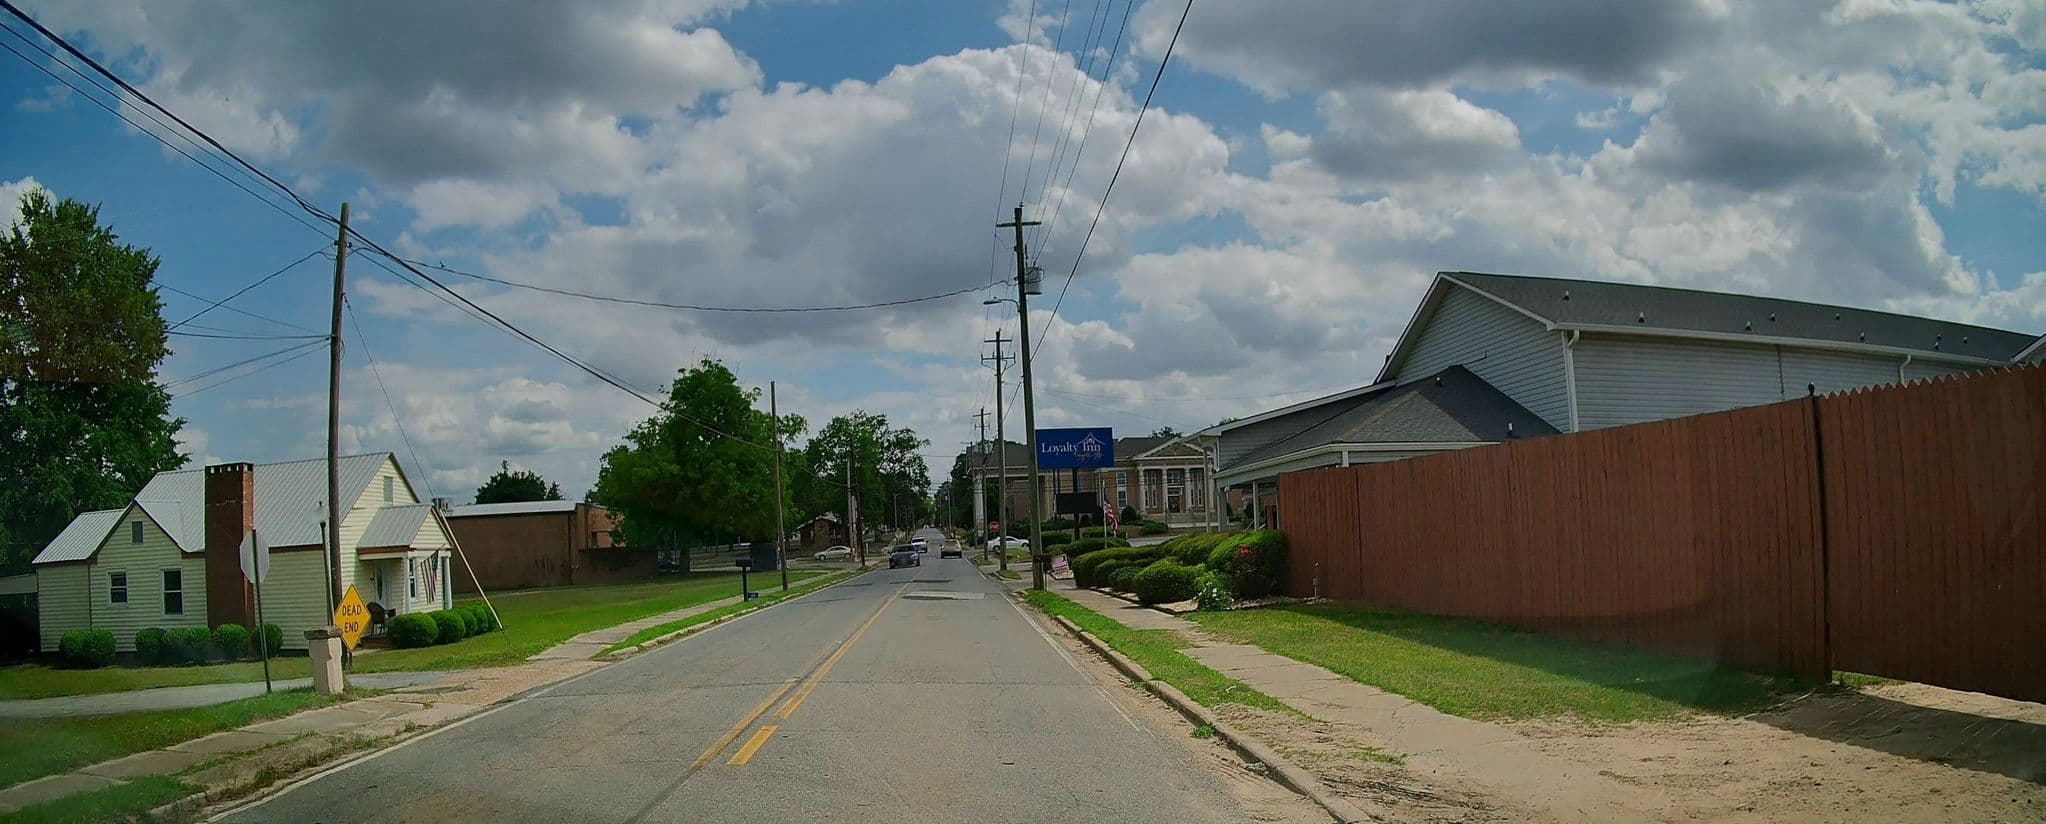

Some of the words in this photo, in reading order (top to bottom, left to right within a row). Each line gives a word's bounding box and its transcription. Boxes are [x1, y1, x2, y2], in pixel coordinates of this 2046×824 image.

[1041, 442, 1078, 456] Loyalty
[1082, 442, 1101, 452] Inn
[341, 604, 362, 617] DEAD
[344, 621, 359, 633] END
